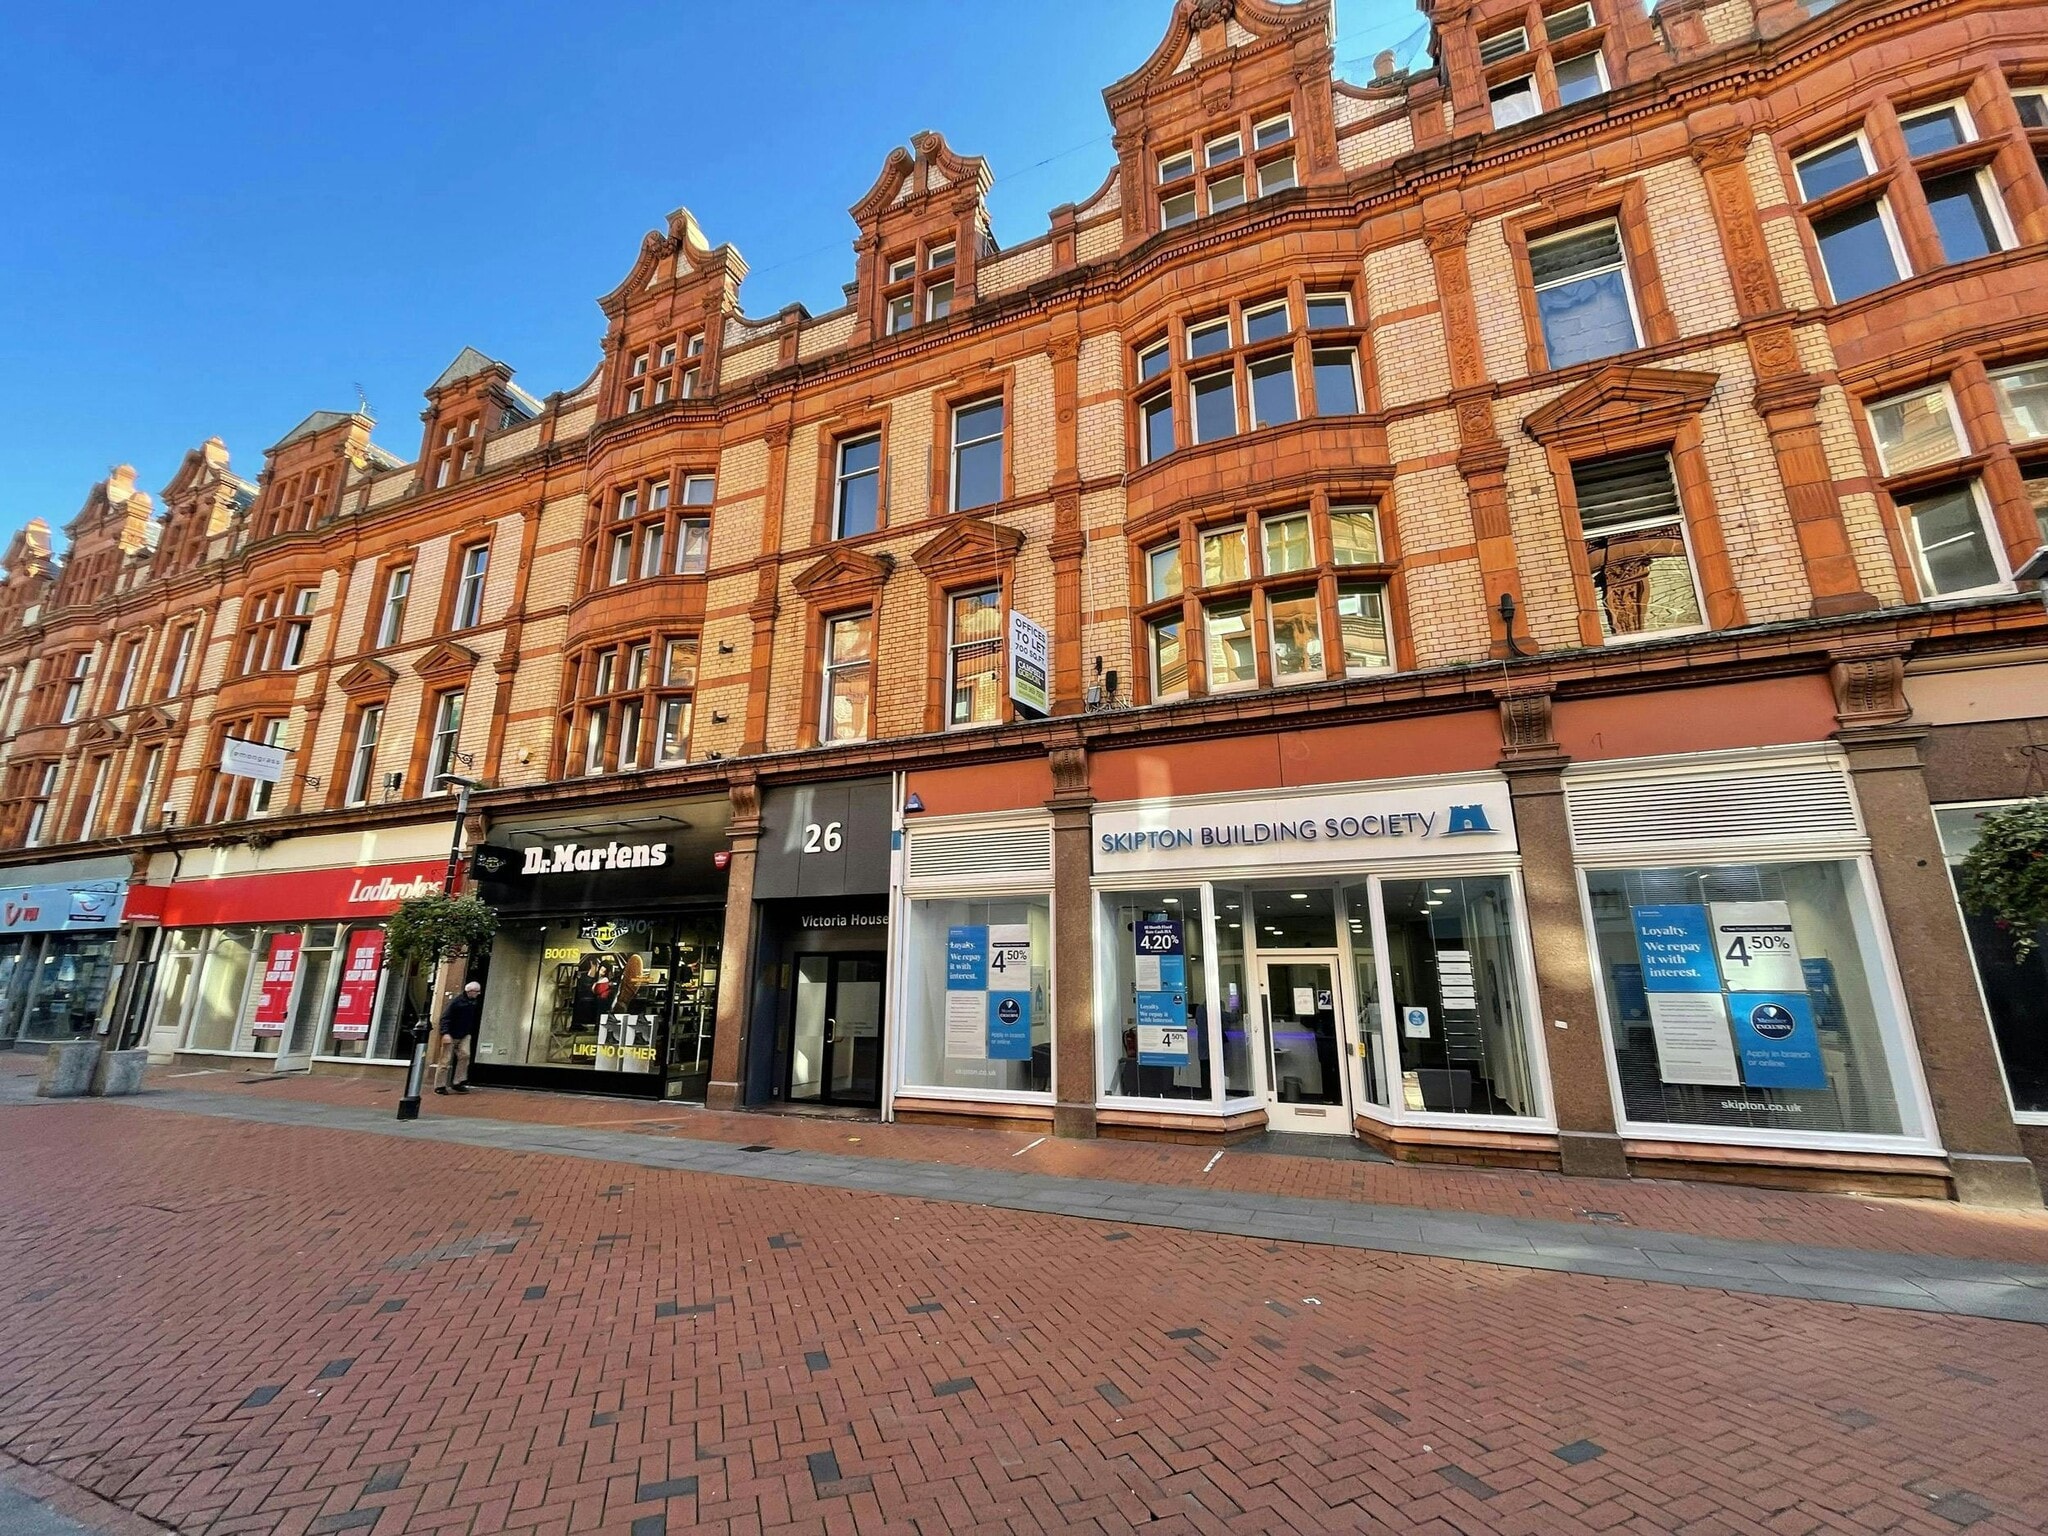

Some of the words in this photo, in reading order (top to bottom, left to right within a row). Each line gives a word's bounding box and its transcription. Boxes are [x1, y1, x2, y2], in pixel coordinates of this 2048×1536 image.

[1015, 618, 1046, 643] OFFICES
[1015, 629, 1029, 645] TO
[1032, 638, 1046, 656] LET
[1015, 642, 1028, 655] 700
[803, 821, 842, 853] 26
[1101, 827, 1193, 853] SKIPTON
[1201, 818, 1318, 848] BUILDING
[1325, 810, 1436, 838] SOCIETY
[802, 914, 847, 927] Victoria
[851, 913, 889, 925] House
[1642, 925, 1688, 937] Loyalty.
[949, 941, 976, 950] Loyalty.
[1140, 934, 1180, 950] 4.20%
[1645, 942, 1665, 952] We
[1667, 942, 1701, 953] repay
[544, 949, 580, 959] BOOTS
[950, 953, 962, 961] We
[962, 954, 981, 962] repay
[1647, 955, 1657, 964] it
[1659, 955, 1687, 965] with
[1650, 967, 1701, 978] interest.
[573, 1043, 597, 1056] LIKE
[598, 1045, 615, 1058] NO
[617, 1046, 656, 1060] OTHER
[1746, 1050, 1770, 1058] Apply
[1721, 1100, 1802, 1113] skipton.co.uk
